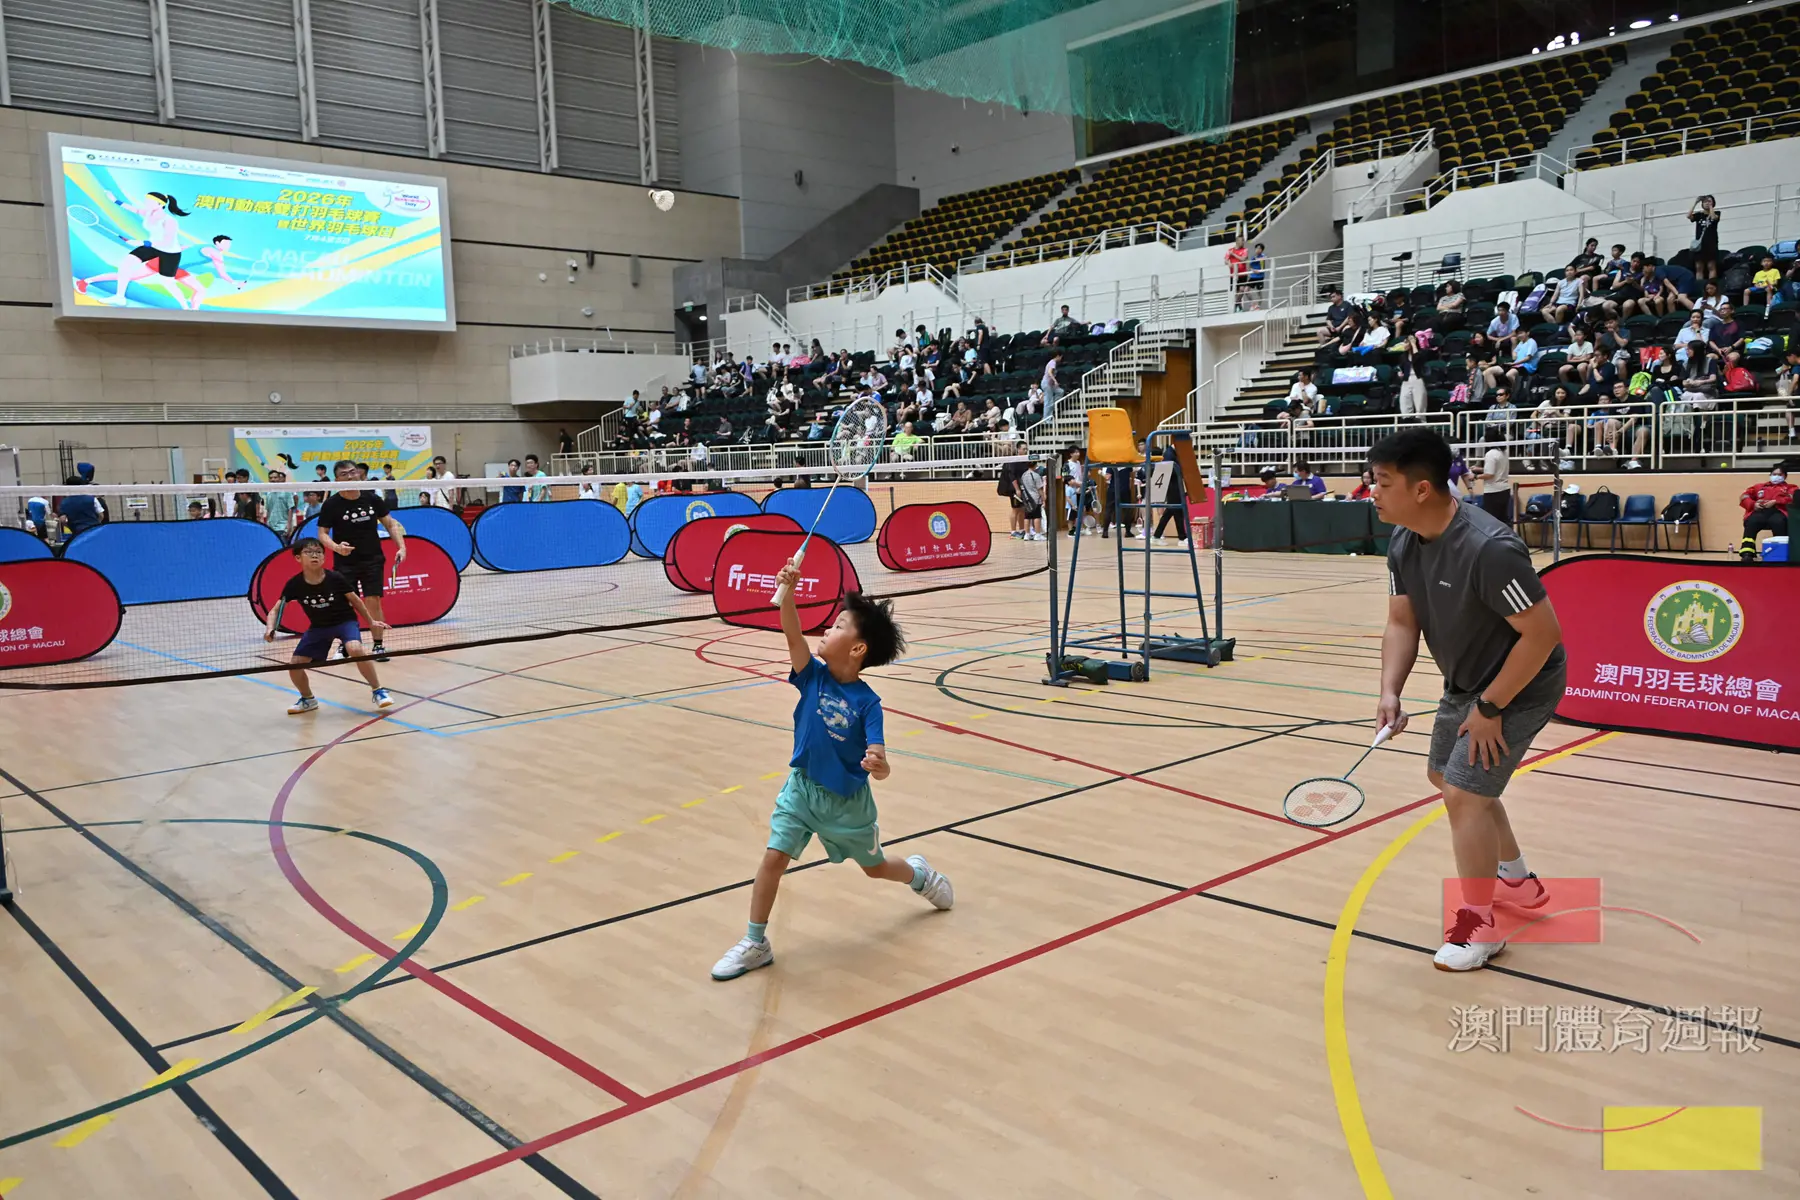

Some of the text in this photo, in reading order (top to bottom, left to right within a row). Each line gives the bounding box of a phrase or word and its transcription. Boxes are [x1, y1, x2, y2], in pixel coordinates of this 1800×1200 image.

[194, 194, 383, 224] 澳門動感雙打羽毛球賽
[277, 189, 354, 208] 2026年
[1155, 473, 1165, 489] 4
[747, 573, 819, 592] FEET
[33, 640, 65, 649] MACAU
[1665, 647, 1675, 656] DE
[1676, 648, 1720, 660] BADMINTON
[1719, 643, 1729, 652] DE
[1727, 622, 1740, 645] MACAU
[1593, 662, 1783, 702] 澳門羽毛球總會
[1565, 686, 1641, 703] BADMINTON
[1644, 694, 1729, 713] FEDERATION
[1733, 704, 1752, 715] OF
